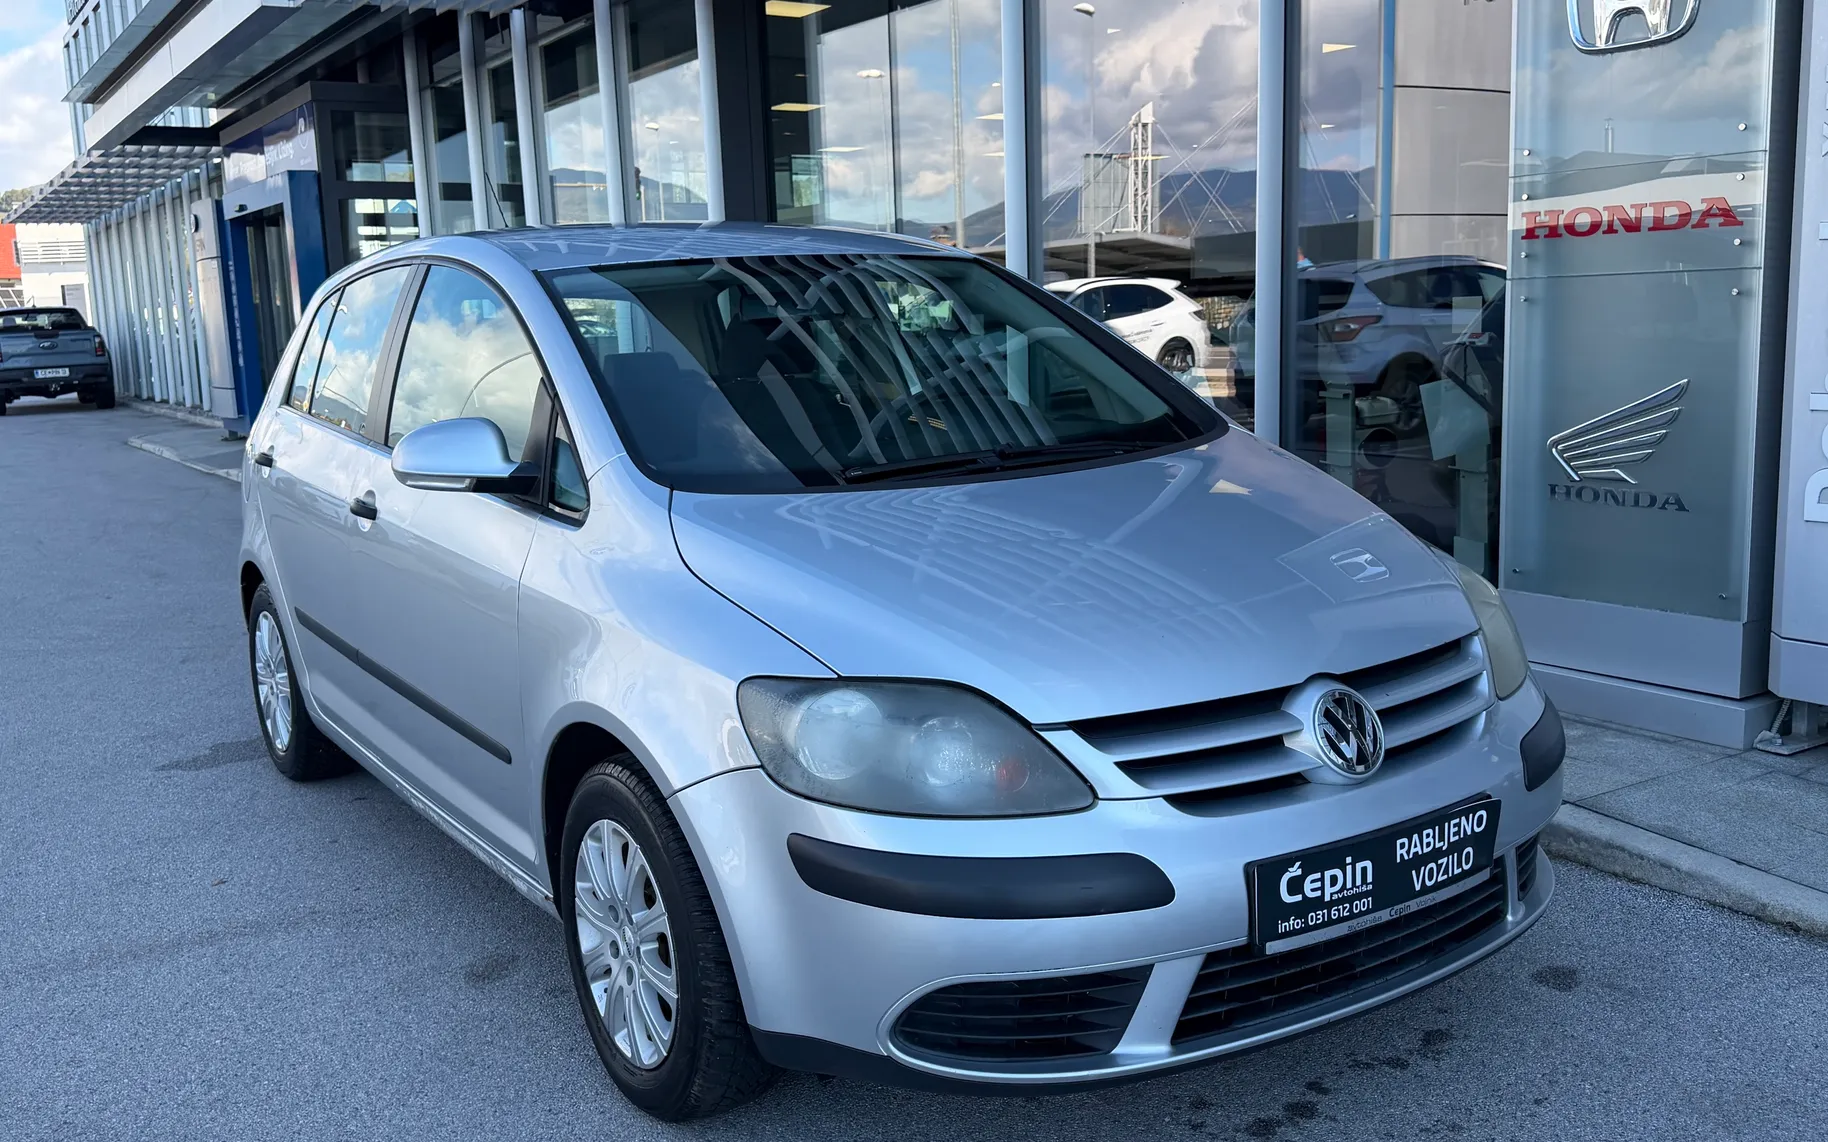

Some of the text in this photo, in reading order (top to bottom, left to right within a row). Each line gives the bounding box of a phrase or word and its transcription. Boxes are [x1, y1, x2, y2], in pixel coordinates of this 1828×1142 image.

[1520, 196, 1744, 240] HONDA
[1547, 483, 1690, 512] HONDA
[1396, 809, 1487, 863] RABLJENO
[1279, 856, 1373, 904] Čepin
[1411, 846, 1474, 892] VOZILO
[1331, 884, 1373, 900] avtohiša
[1278, 897, 1372, 934] info: 031 612 001
